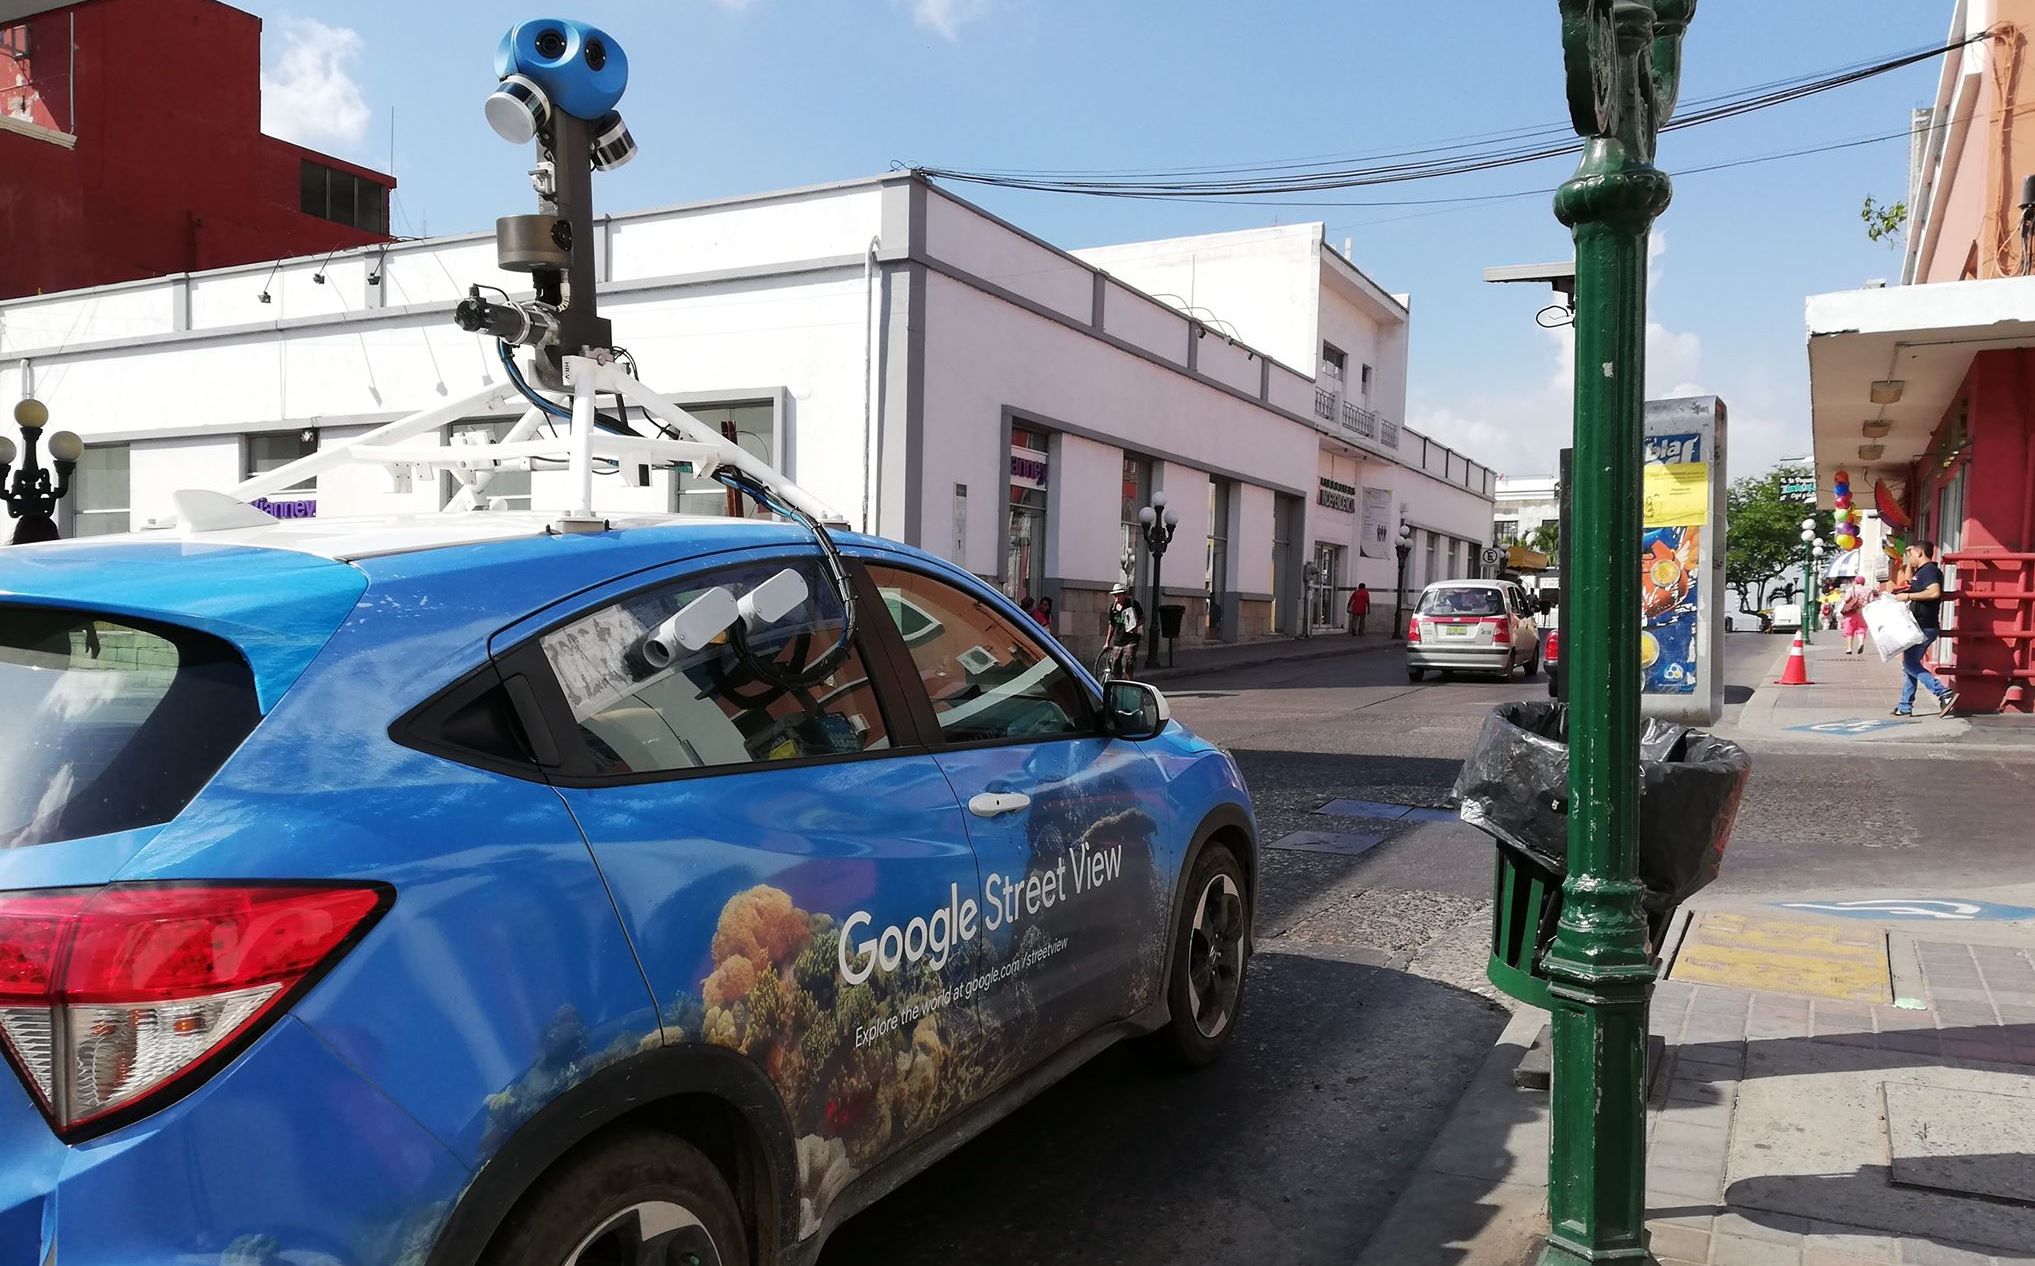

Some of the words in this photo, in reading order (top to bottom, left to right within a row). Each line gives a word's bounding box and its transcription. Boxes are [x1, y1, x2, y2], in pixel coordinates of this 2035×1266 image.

[1011, 456, 1047, 486] anney
[838, 883, 977, 985] Google
[985, 857, 1066, 931] Street
[1069, 842, 1122, 895] View
[855, 1016, 898, 1048] Explore
[901, 1005, 919, 1025] the
[921, 985, 952, 1014] world
[953, 982, 965, 1001] at
